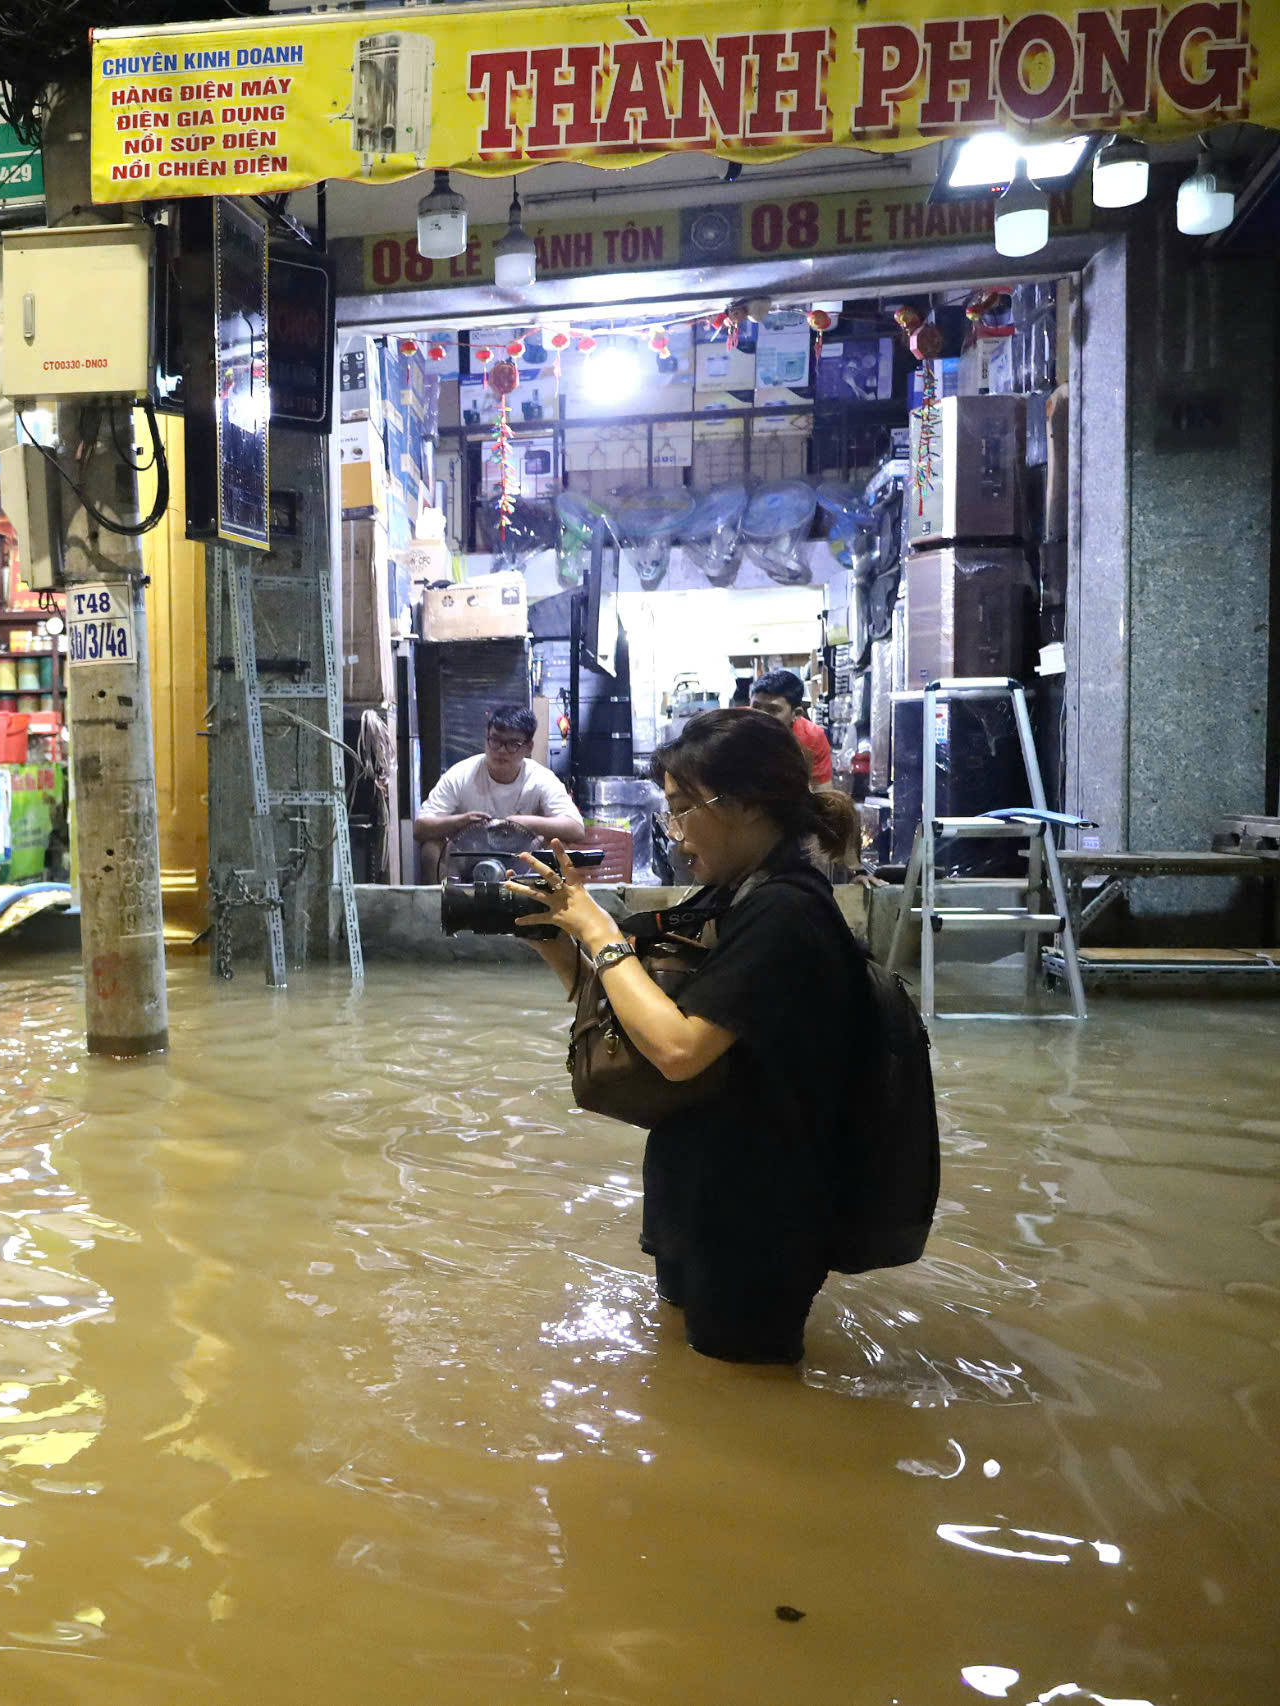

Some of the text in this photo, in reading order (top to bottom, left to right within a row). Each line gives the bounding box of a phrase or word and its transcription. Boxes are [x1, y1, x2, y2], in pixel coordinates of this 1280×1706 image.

[102, 45, 304, 76] CHUYÊN KINH DOANH
[111, 76, 292, 106] HÀNG ĐIỆN MÁY
[467, 1, 1256, 160] THÀNH PHONG
[117, 105, 286, 132] ĐIỆN GIA DỤNG
[170, 133, 216, 152] SÚP
[222, 128, 277, 151] ĐIỆN
[158, 158, 227, 177] CHIÊN
[234, 153, 289, 176] ĐIỆN
[750, 201, 820, 253] 08
[836, 199, 873, 245] LÊ
[372, 237, 434, 285] 08
[603, 220, 665, 265] TÔN
[74, 592, 111, 615] T48
